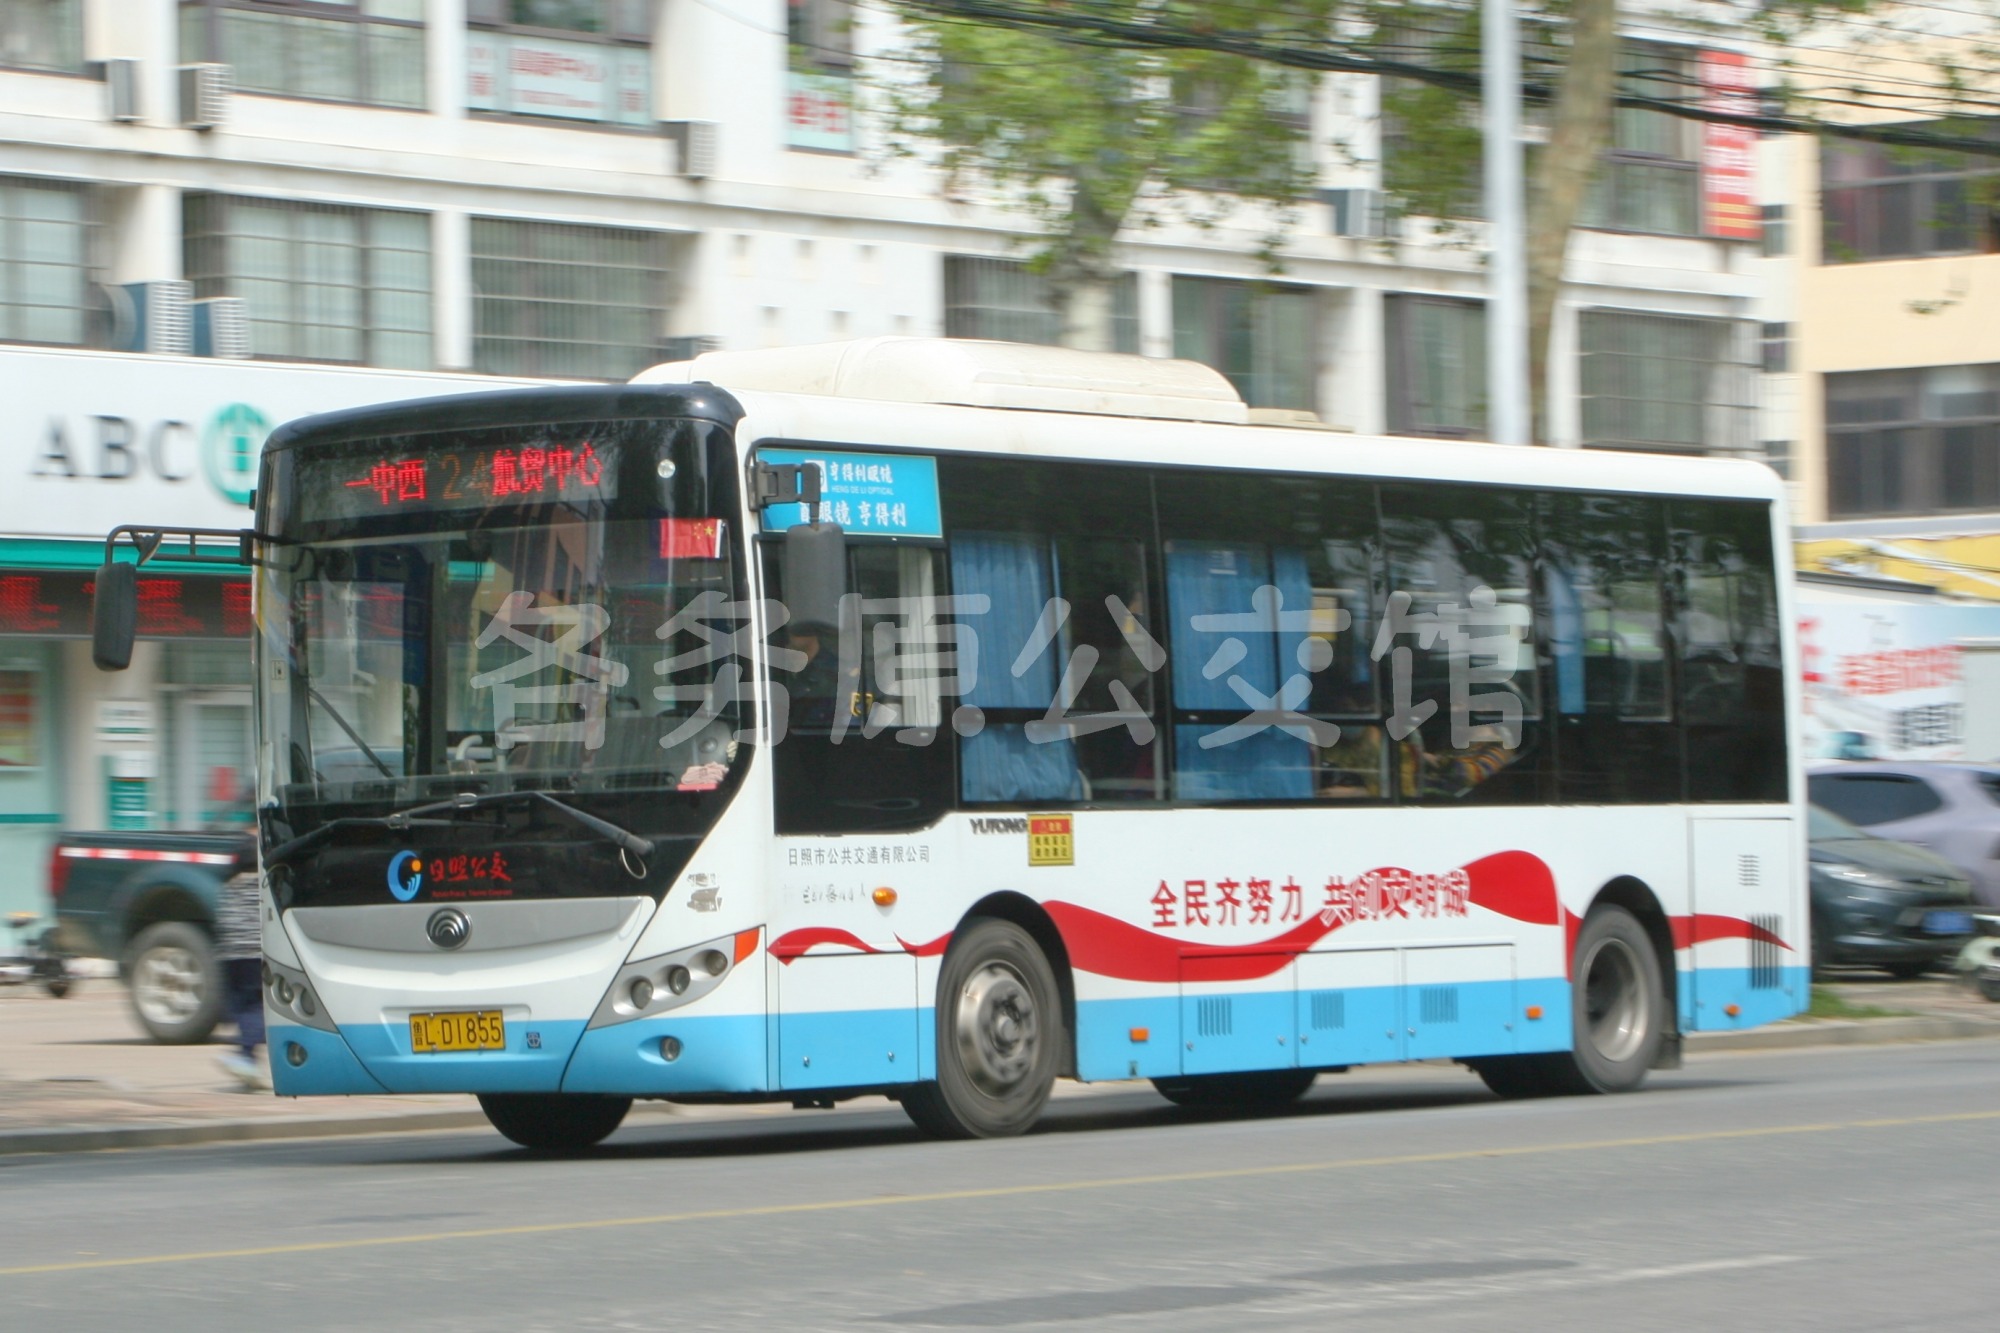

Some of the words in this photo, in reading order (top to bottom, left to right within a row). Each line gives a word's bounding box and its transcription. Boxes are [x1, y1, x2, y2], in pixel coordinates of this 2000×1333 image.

[31, 415, 196, 482] ABC
[344, 458, 426, 505] 一中西
[440, 453, 492, 499] 24
[491, 441, 603, 497] 航贸中心
[830, 461, 894, 483] 亨得利眼镜
[857, 501, 907, 527] 亨得利
[968, 818, 1028, 835] YUTONG
[789, 846, 930, 866] 日照市公共交通有限公司
[1150, 874, 1303, 928] 全民齐努力
